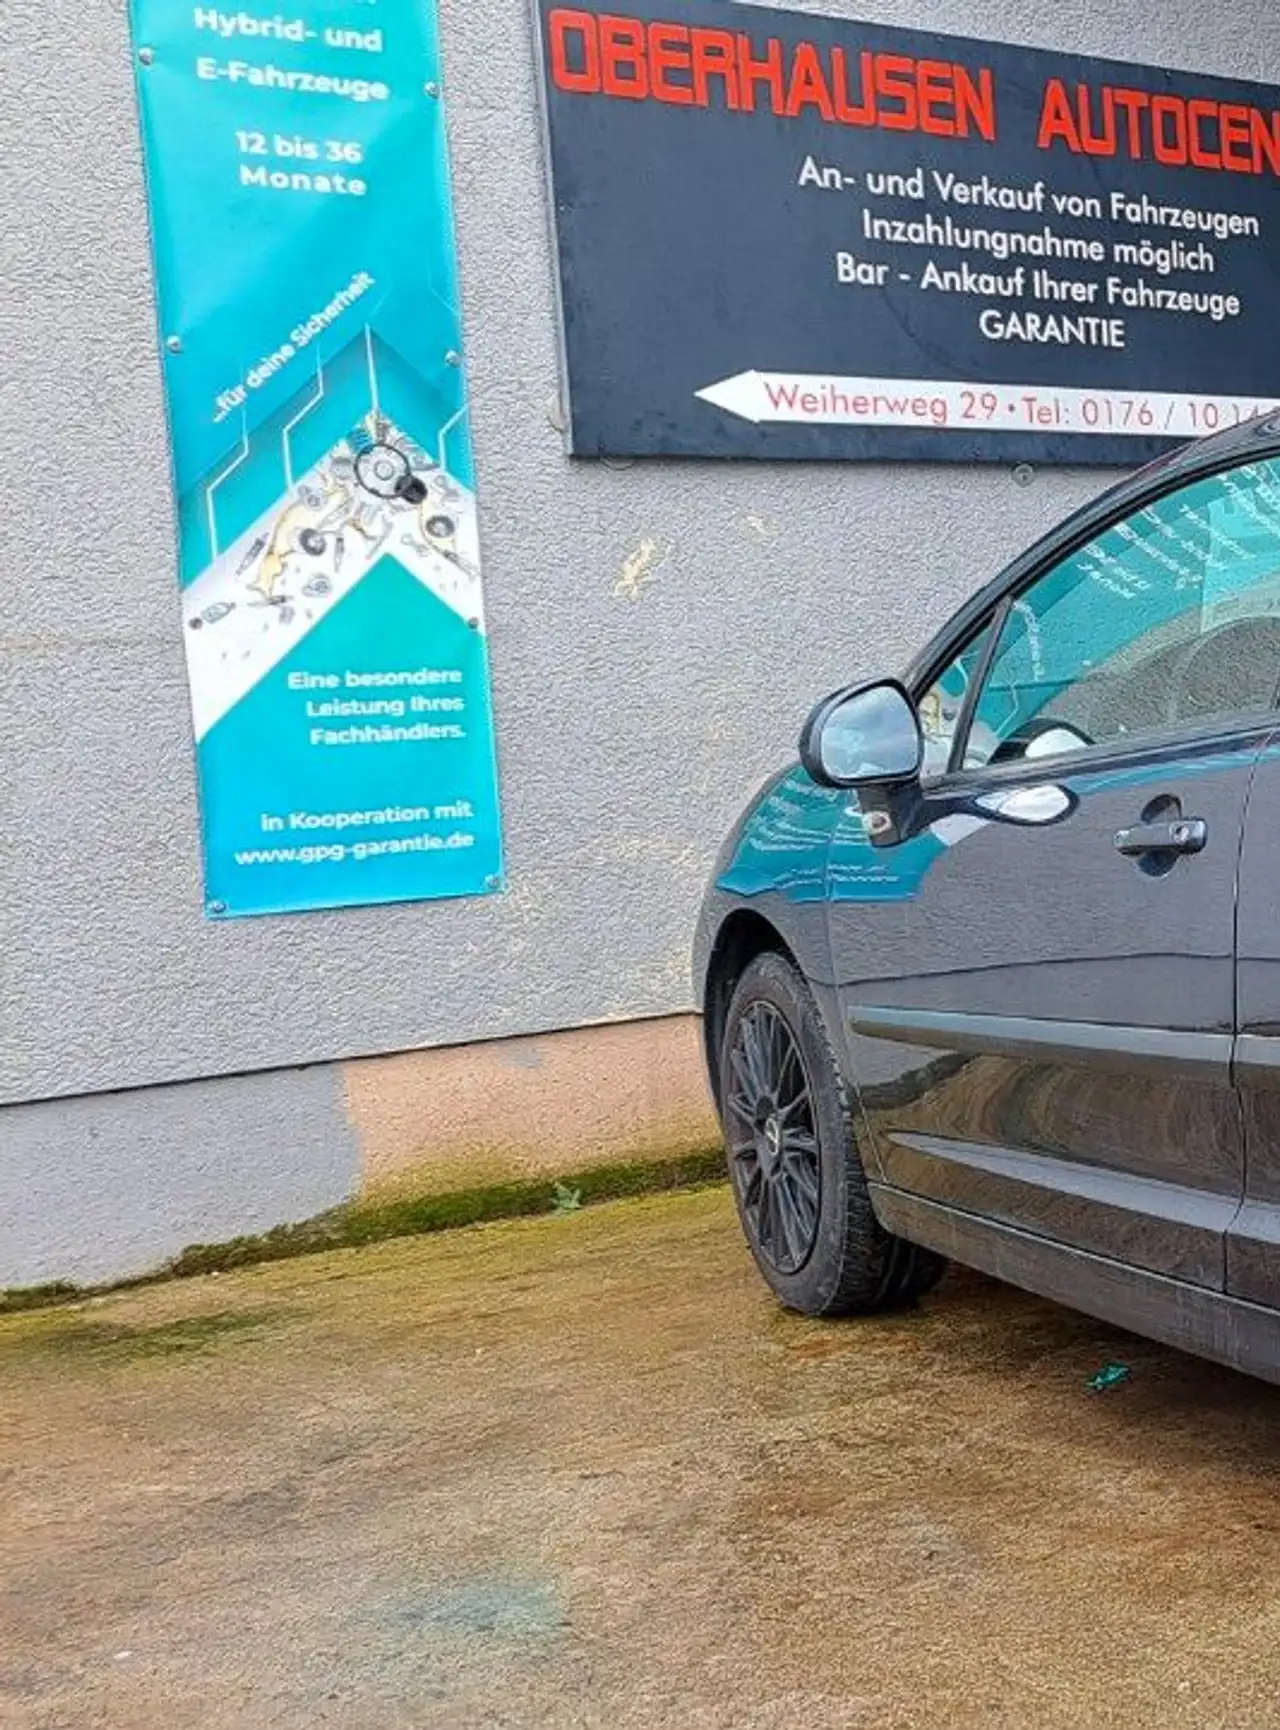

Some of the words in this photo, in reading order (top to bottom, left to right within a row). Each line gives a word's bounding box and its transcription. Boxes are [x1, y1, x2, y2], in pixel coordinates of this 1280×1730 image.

[193, 7, 318, 42] Hybrid-
[324, 28, 384, 53] und
[196, 56, 391, 102] E-Fahrzeuge
[548, 8, 996, 142] OBERHAUSEN
[236, 130, 268, 155] 12
[273, 134, 319, 160] bis
[325, 140, 363, 164] 36
[240, 164, 367, 196] Monate
[799, 155, 855, 190] An-
[866, 167, 925, 199] und
[932, 170, 1046, 212] Verkauf
[1051, 193, 1101, 219] von
[1110, 191, 1260, 239] Fahrzeugen
[863, 208, 1106, 261] Inzahlungnahme
[1113, 239, 1214, 275] möglich
[836, 252, 890, 286] Bar
[920, 260, 1025, 297] Ankauf
[1033, 268, 1099, 303] Ihrer
[1106, 276, 1240, 321] Fahrzeuge
[246, 344, 296, 388] deine
[290, 271, 376, 347] Sicherheit
[979, 309, 1126, 348] GARANTIE
[763, 381, 948, 425] Weiherweg
[959, 390, 998, 420] 29
[1021, 397, 1070, 424] Tel:
[1082, 398, 1154, 427] 0176
[1188, 401, 1219, 428] 10
[287, 671, 341, 690] Eine
[345, 667, 462, 688] besondere
[306, 698, 405, 717] Leistung
[410, 694, 464, 712] Ihres
[310, 722, 467, 745] Fachhändlers.
[289, 804, 430, 830] Kooperation
[435, 799, 474, 820] mit
[233, 830, 474, 865] www.gpg-garantie.de
